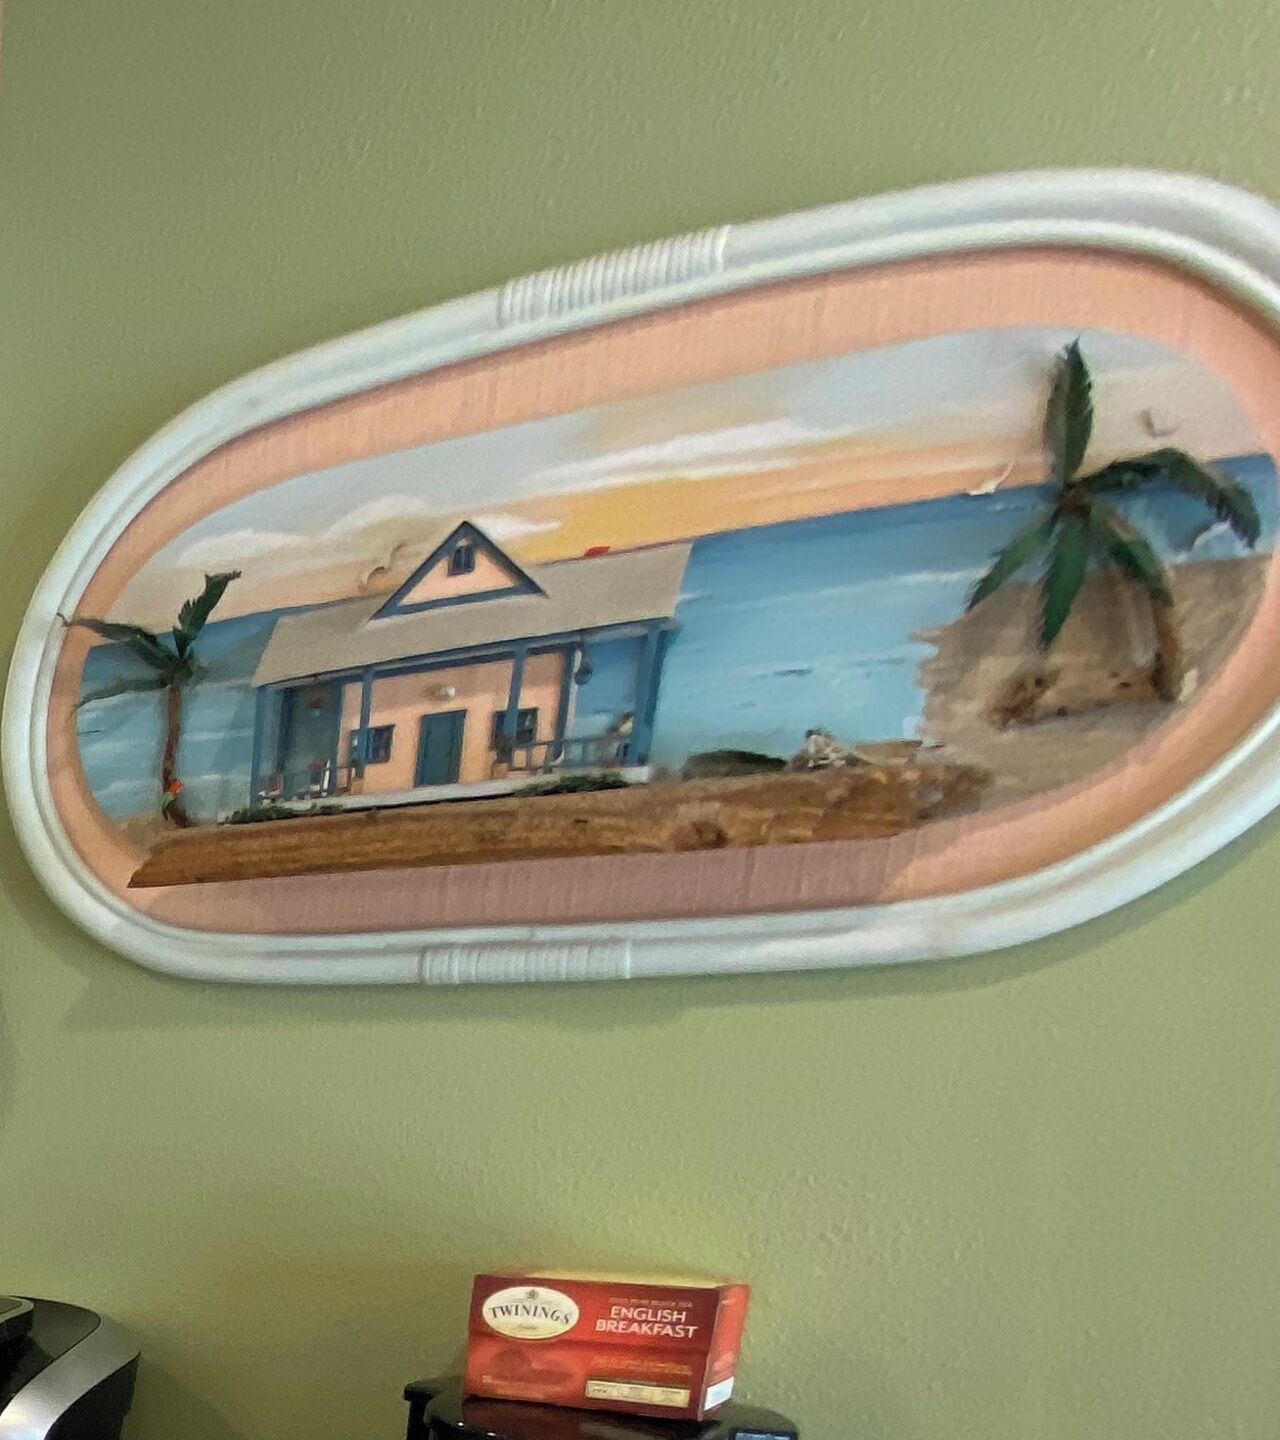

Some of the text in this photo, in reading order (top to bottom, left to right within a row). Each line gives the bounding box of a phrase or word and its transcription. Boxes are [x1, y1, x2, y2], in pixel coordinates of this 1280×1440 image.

[489, 1304, 572, 1325] TWININGS
[610, 1305, 686, 1323] ENGLISH
[595, 1318, 698, 1339] BREAKFAST
